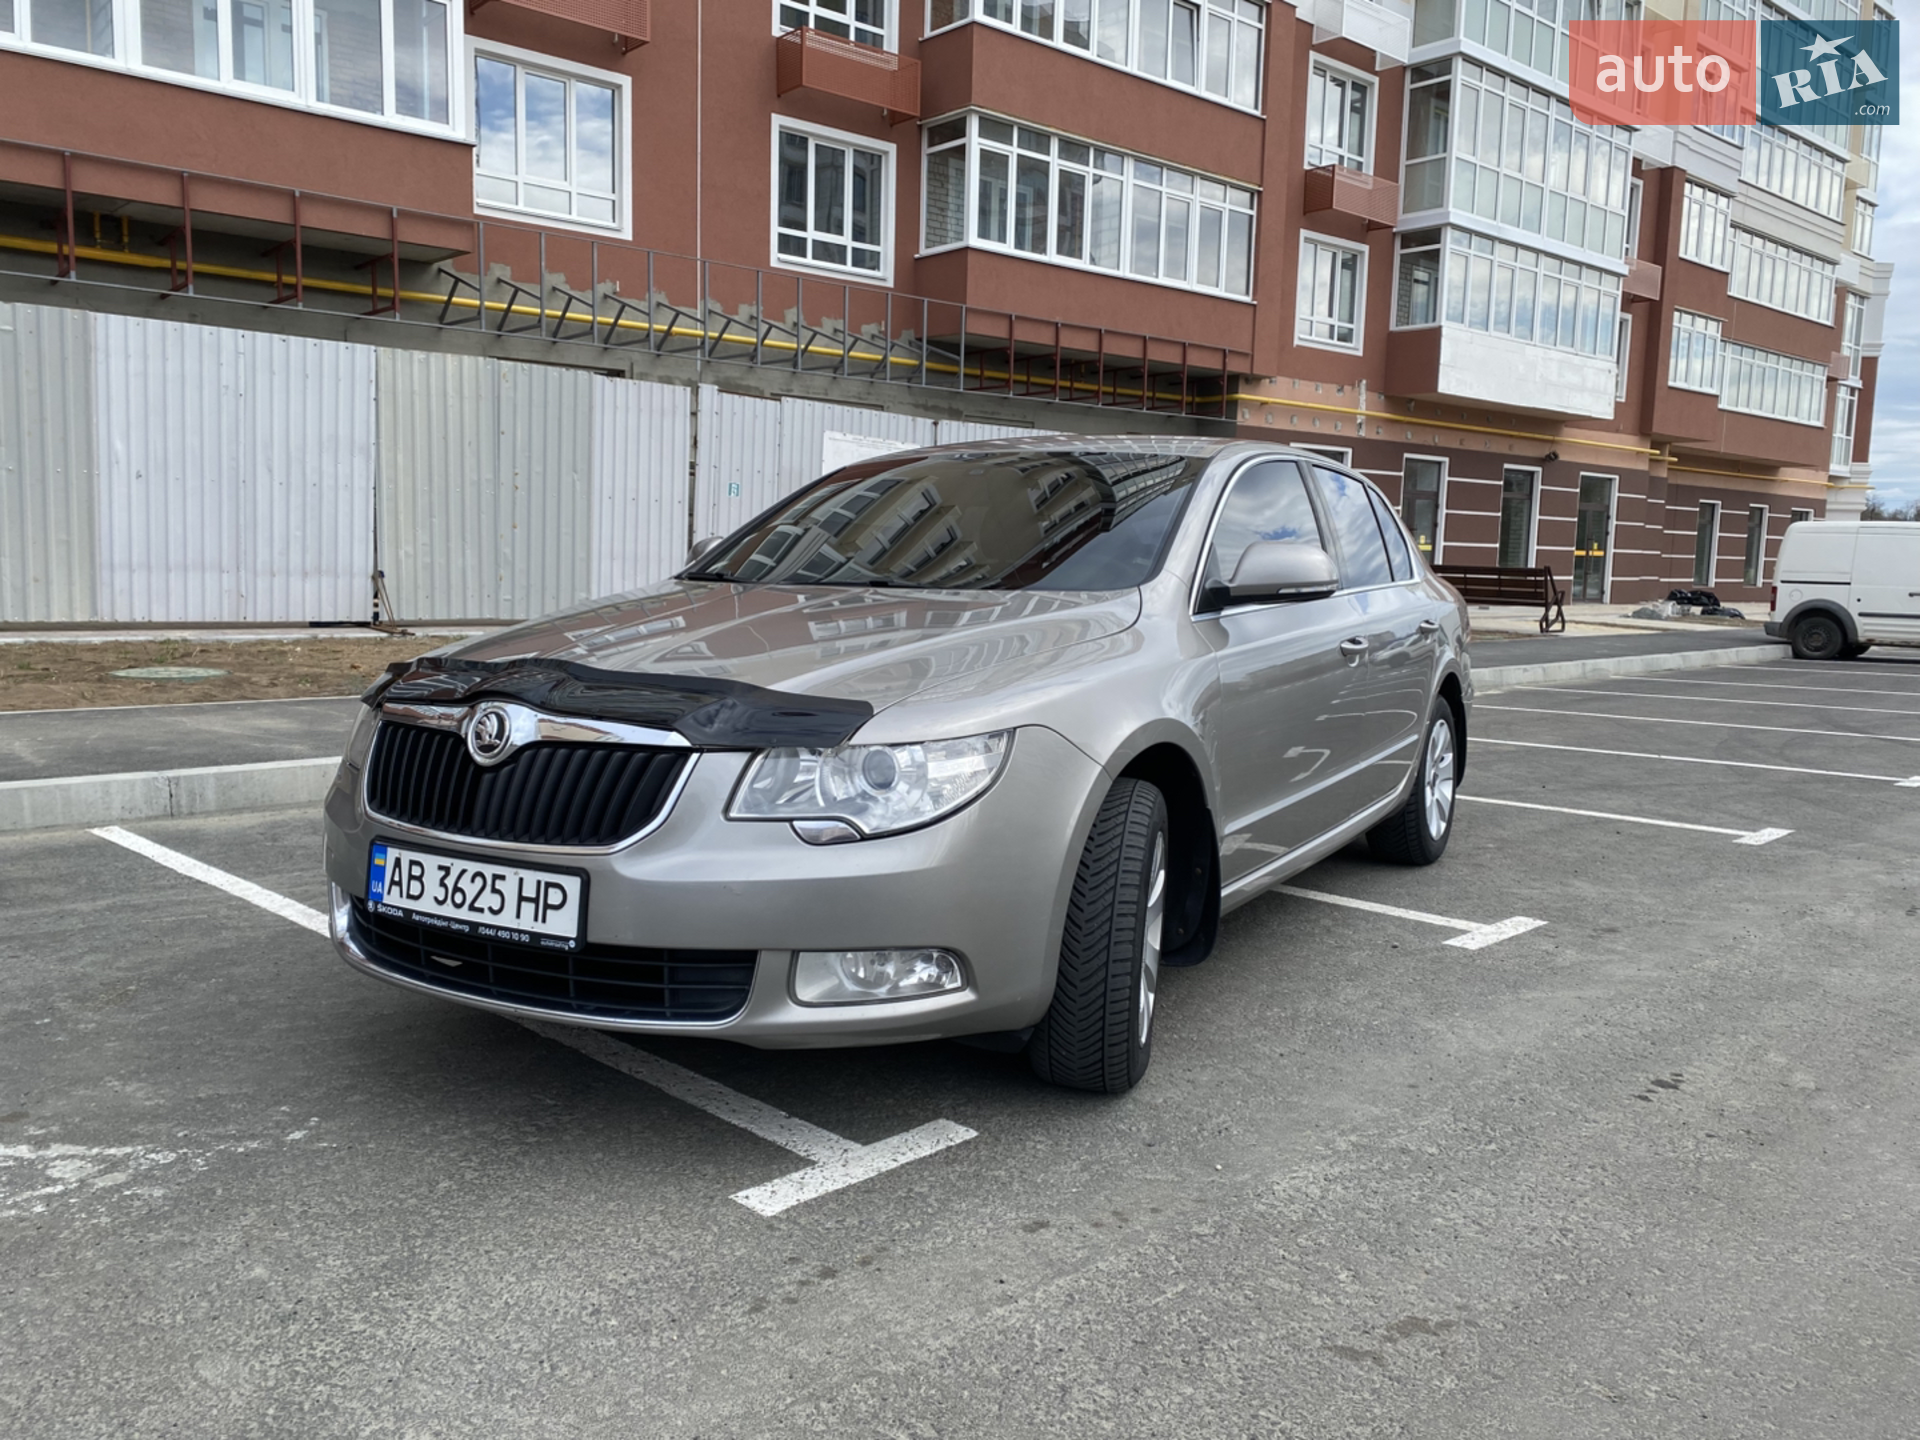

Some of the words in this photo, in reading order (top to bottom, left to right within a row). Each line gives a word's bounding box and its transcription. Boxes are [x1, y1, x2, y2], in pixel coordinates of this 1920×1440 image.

[371, 880, 383, 894] UA
[386, 856, 426, 901] AB
[433, 864, 506, 916] 3625
[516, 876, 568, 924] HP
